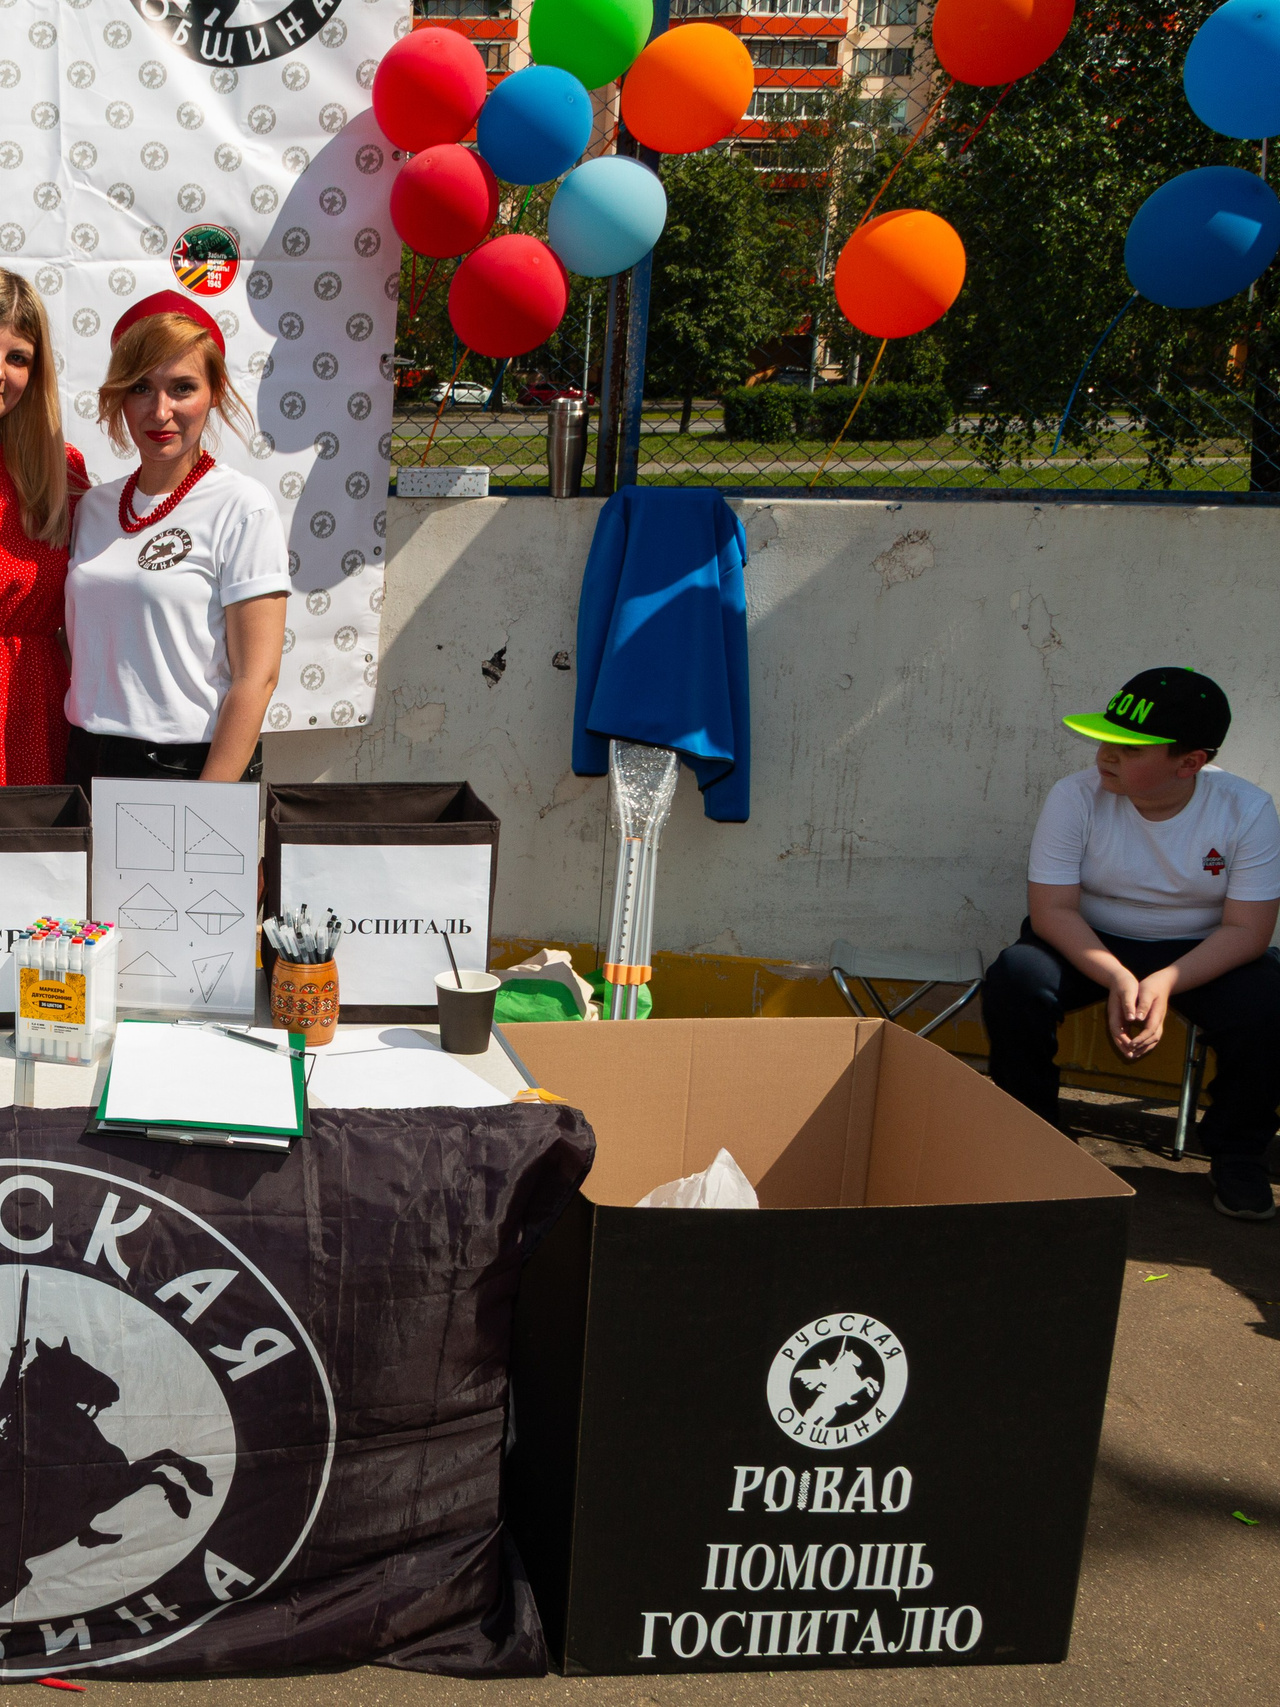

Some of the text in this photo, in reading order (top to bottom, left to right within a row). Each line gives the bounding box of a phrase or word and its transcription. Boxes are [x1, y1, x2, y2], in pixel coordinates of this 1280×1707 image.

[152, 528, 192, 550] РУССКАЯ
[138, 555, 176, 571] ОБЩИНА
[343, 918, 473, 935] ОСПИТАЛЬ
[31, 993, 73, 1001] ДВУСТОРОННИЕ
[39, 986, 65, 994] МАРКЕРЫ
[781, 1315, 902, 1361] РУССКАЯ
[777, 1406, 887, 1445] ОБЩИНА
[807, 1466, 914, 1512] ВАО
[701, 1542, 934, 1601] ПОМОЩЬ
[637, 1605, 984, 1658] ГОСПИТАЛЮ
